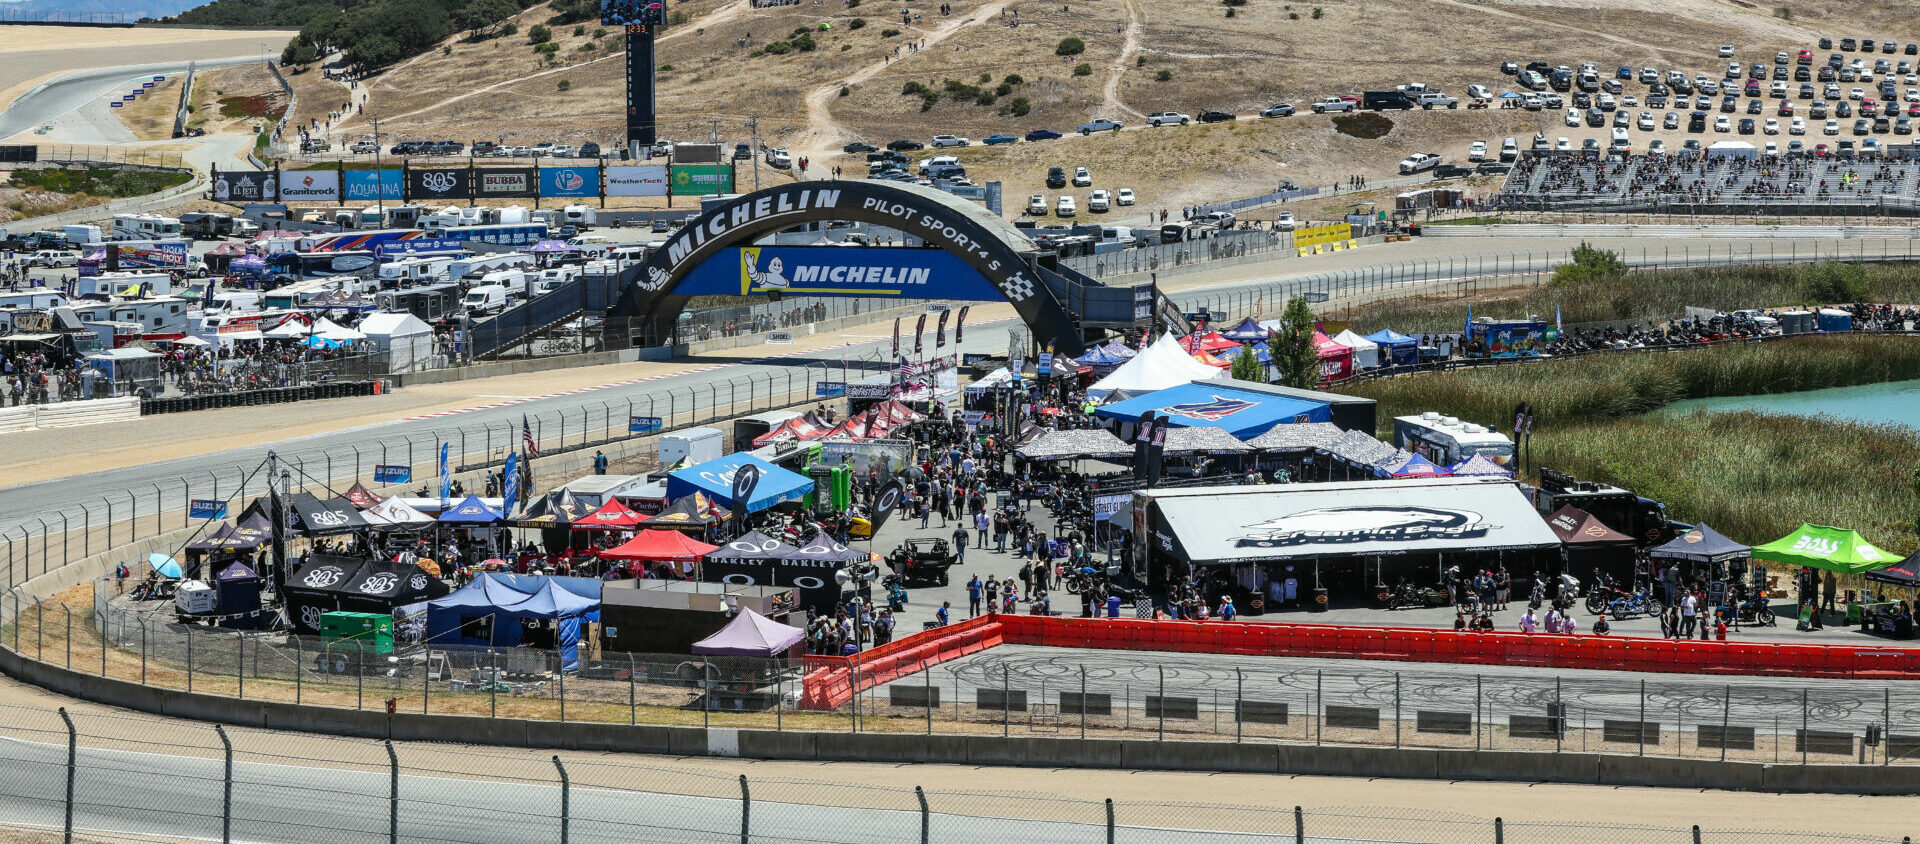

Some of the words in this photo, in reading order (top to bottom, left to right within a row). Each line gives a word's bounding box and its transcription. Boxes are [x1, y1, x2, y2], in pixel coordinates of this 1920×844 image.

[422, 172, 457, 188] 805
[485, 176, 523, 185] BUBBA
[234, 187, 242, 195] EL
[242, 187, 258, 197] JEFE
[283, 187, 335, 195] Graniterock
[668, 189, 841, 266] MICHELIN
[863, 197, 918, 220] PILOT
[920, 215, 981, 252] SPORT
[979, 251, 989, 259] 4
[988, 260, 1001, 271] S
[793, 265, 931, 285] MICHELIN
[631, 417, 662, 425] SUZUKI
[376, 467, 409, 475] SUZUKI
[1095, 501, 1113, 514] STREET
[311, 510, 349, 525] 805
[1404, 523, 1493, 535] Eagle
[710, 556, 764, 567] OAKLEY
[781, 559, 837, 568] OAKLEY
[845, 554, 870, 566] OAKLEY
[303, 569, 345, 587] 805
[359, 576, 400, 593] 805
[410, 575, 428, 588] 805
[301, 604, 329, 625] 80
